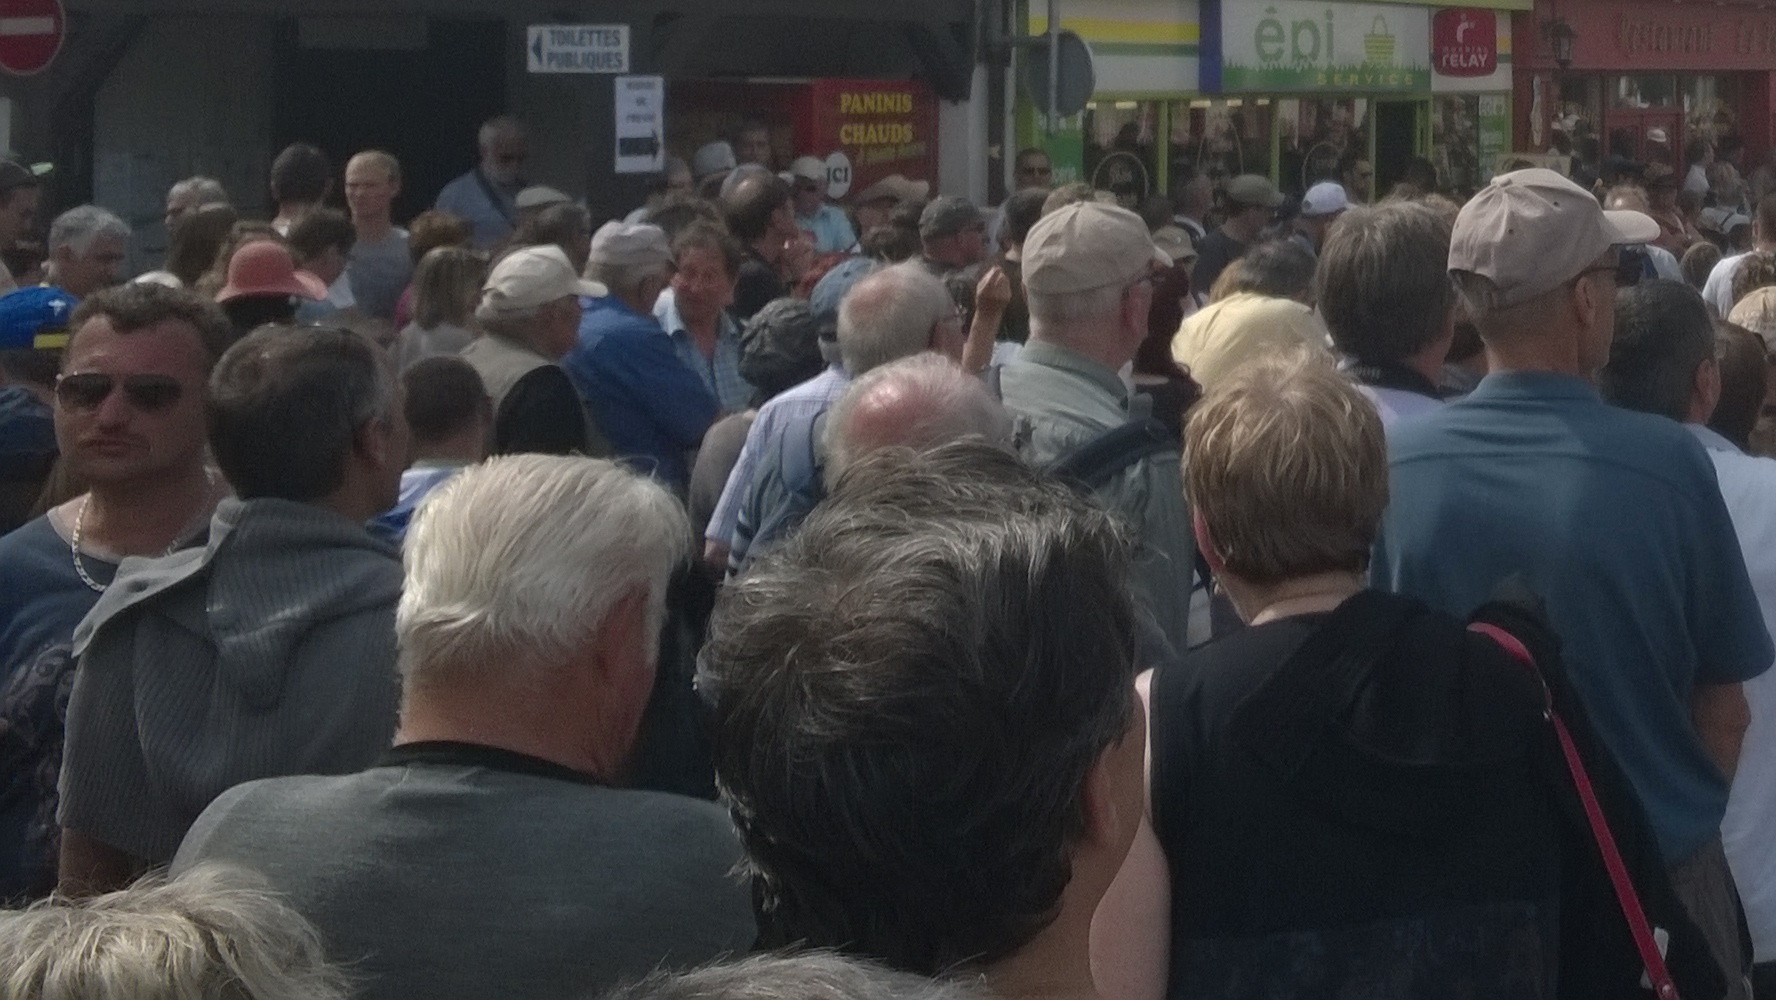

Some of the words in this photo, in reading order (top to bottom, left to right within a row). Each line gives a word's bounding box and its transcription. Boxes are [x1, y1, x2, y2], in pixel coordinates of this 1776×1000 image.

[547, 28, 621, 48] TOILETTES
[1254, 5, 1335, 70] épi
[547, 51, 623, 71] PUBLIQUES
[1316, 72, 1414, 86] SERVICE
[840, 93, 913, 114] PANINIS
[840, 123, 914, 145] CHAUDS
[826, 167, 849, 184] ICI
